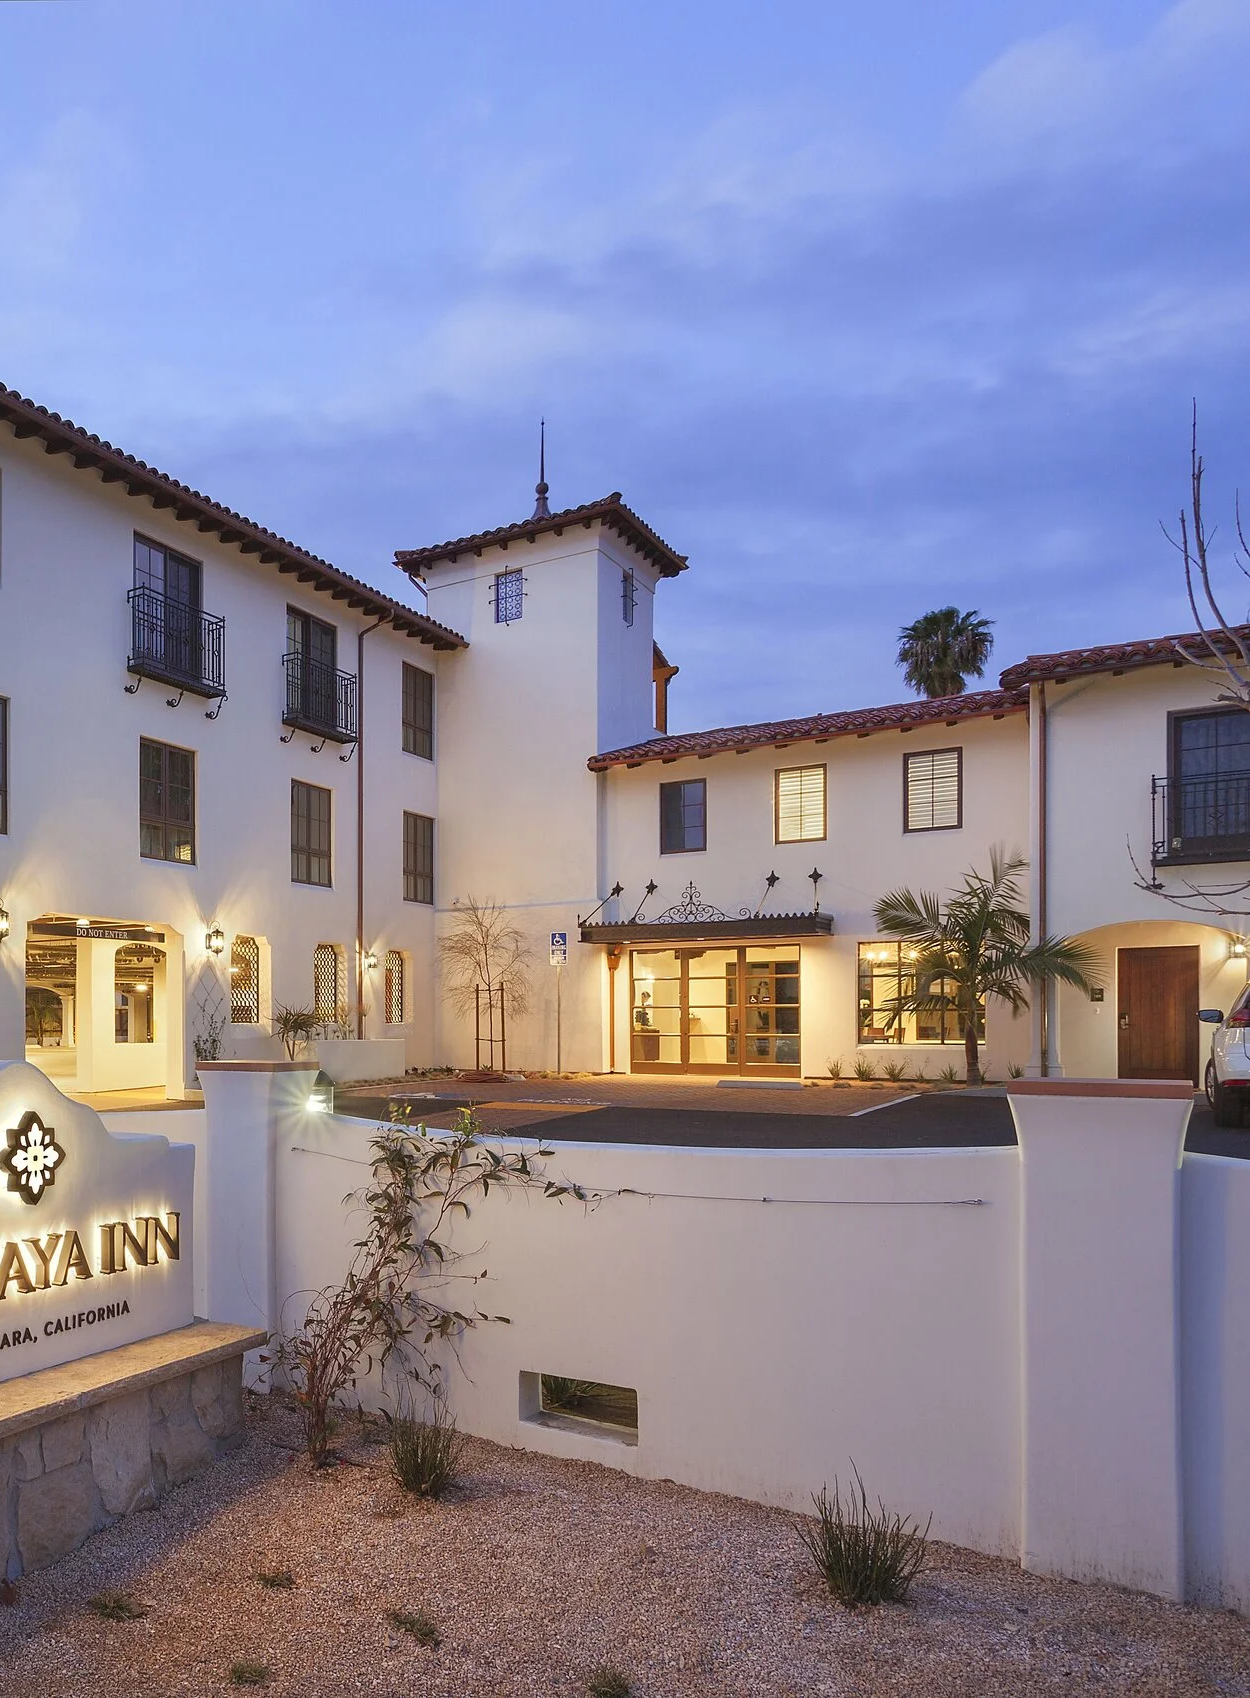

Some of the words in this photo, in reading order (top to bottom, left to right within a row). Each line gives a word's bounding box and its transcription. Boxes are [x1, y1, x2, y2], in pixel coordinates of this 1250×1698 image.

[76, 928, 87, 937] DO
[88, 929, 104, 938] NOT
[104, 930, 128, 939] ENTER
[98, 1211, 180, 1275] INN
[43, 1299, 130, 1337] CALIFORNIA
